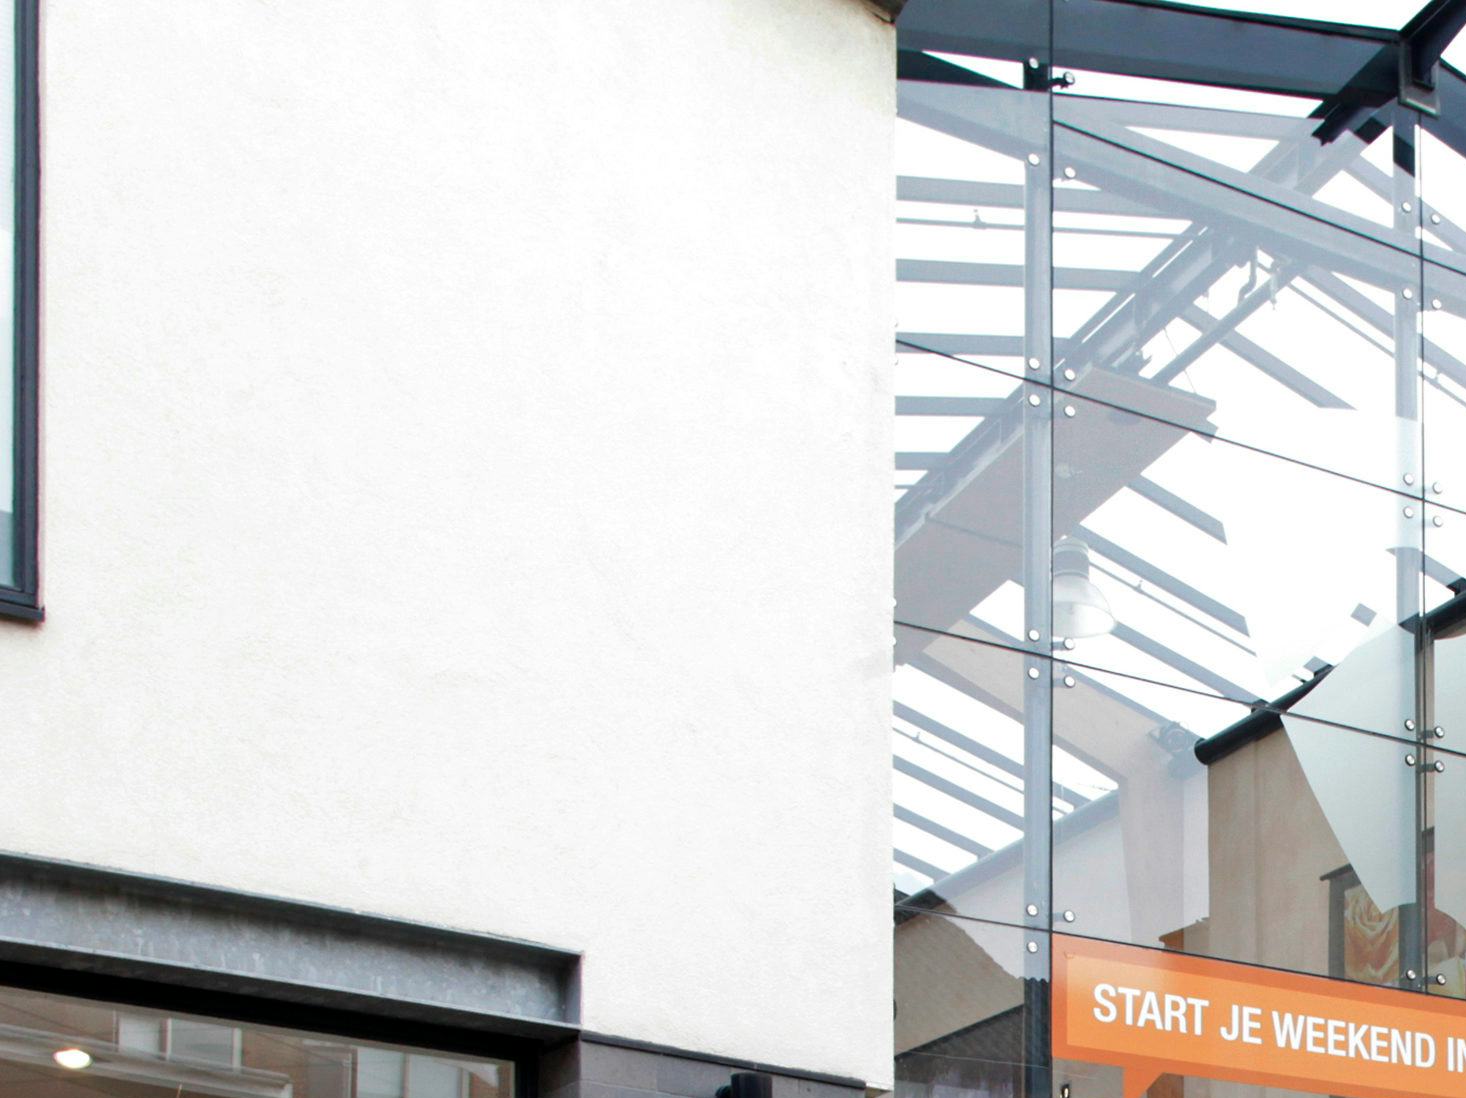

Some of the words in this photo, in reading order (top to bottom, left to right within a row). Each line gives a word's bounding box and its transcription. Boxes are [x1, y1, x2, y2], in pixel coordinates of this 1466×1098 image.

[1092, 983, 1209, 1036] START
[1219, 1003, 1262, 1044] JE
[1271, 1011, 1437, 1069] WEEKEND
